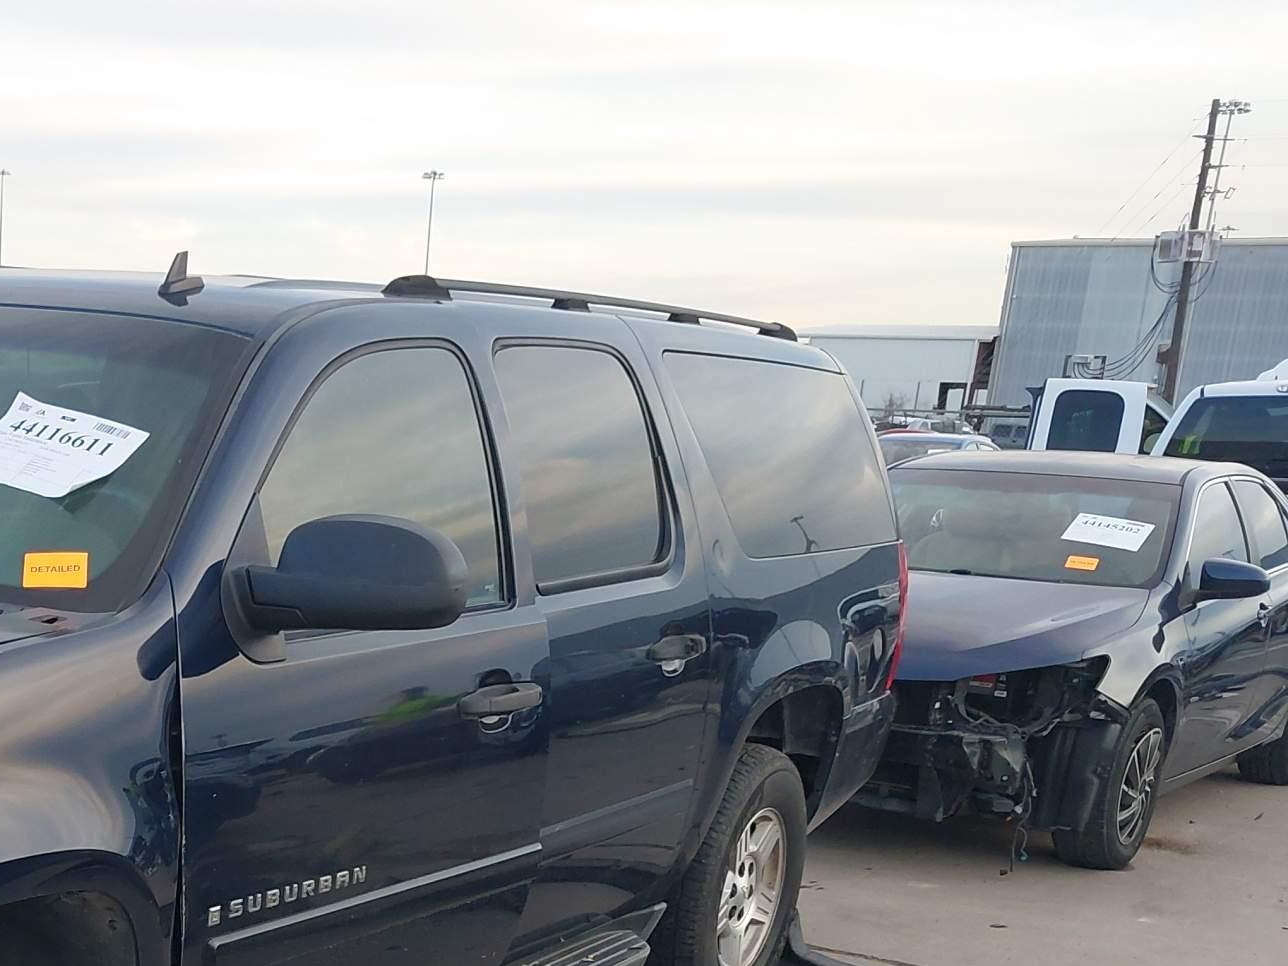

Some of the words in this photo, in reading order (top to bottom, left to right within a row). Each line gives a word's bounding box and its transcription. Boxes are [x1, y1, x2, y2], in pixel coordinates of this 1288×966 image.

[9, 419, 113, 456] 44116611
[30, 564, 81, 573] DETAILED
[228, 865, 367, 919] SUBURBAN
